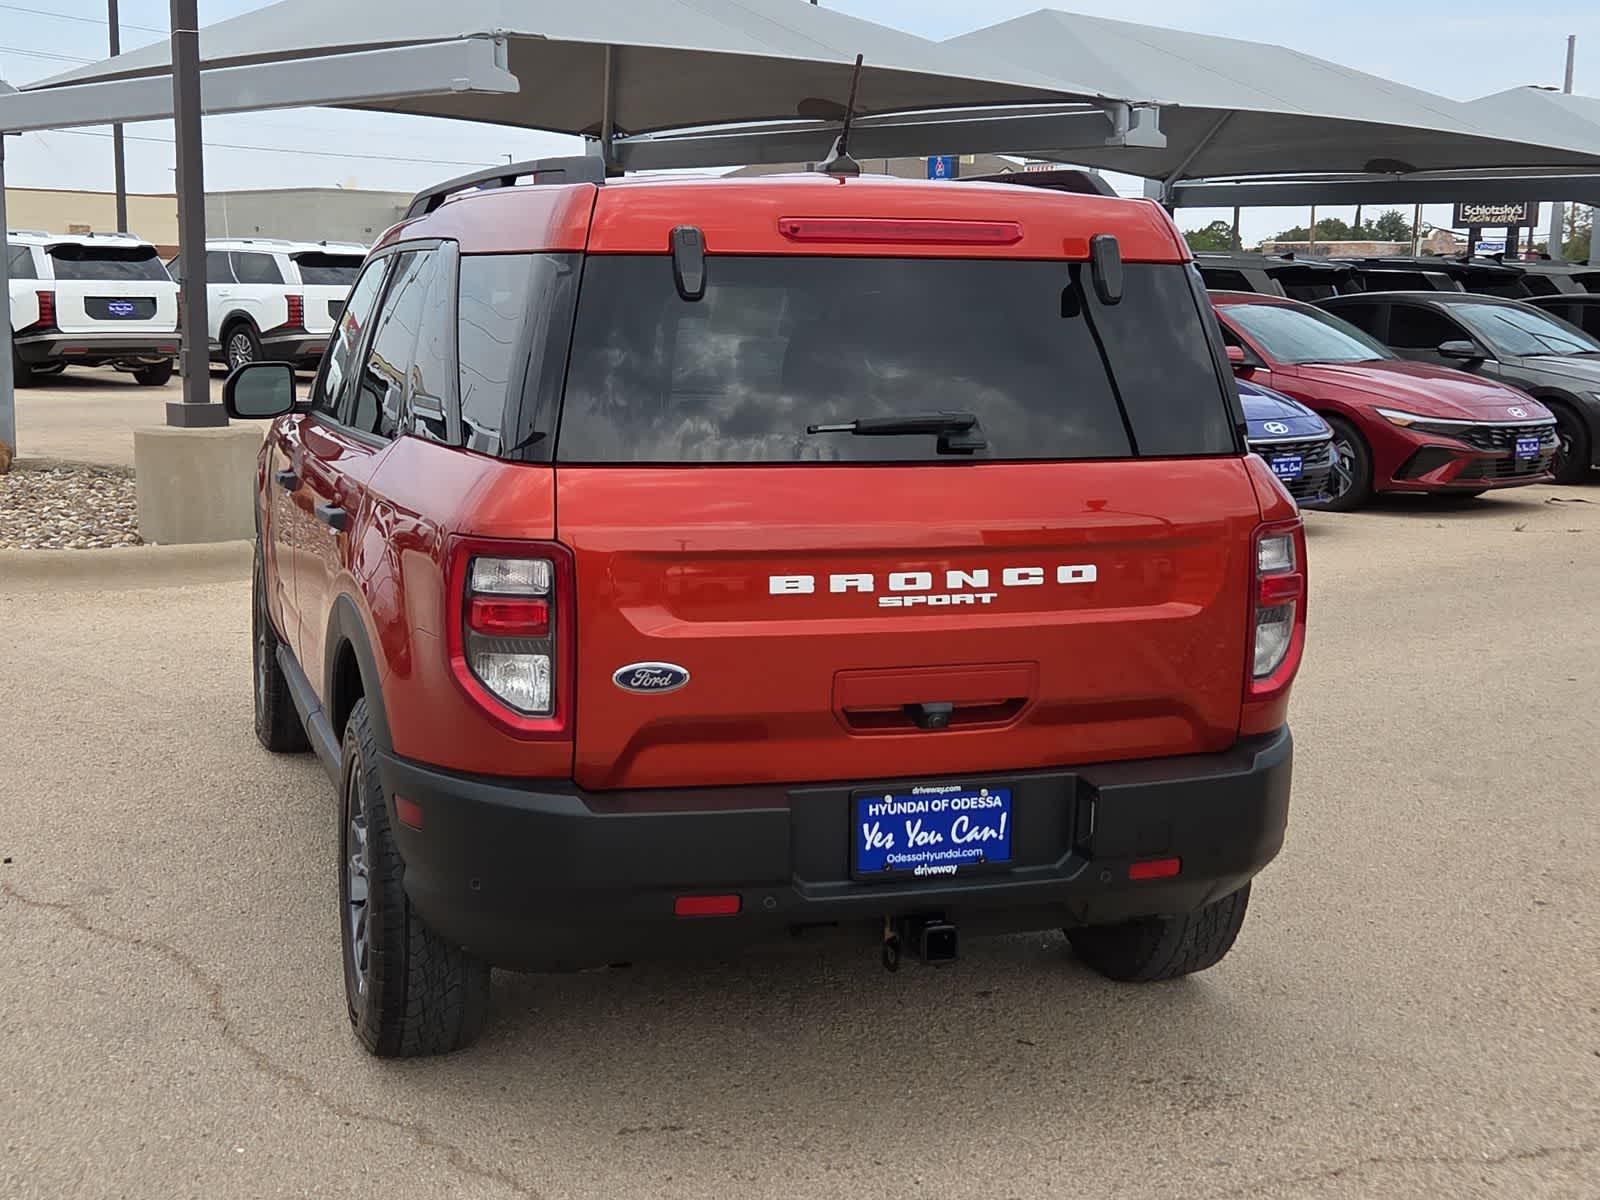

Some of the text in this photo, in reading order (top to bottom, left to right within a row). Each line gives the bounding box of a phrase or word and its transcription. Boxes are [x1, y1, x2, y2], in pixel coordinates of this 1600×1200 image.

[1464, 204, 1522, 216] Schlotzsky's
[769, 564, 1097, 594] BRONCO
[878, 593, 997, 607] SPORT
[630, 669, 672, 686] Ford
[912, 785, 961, 795] driveway.com
[868, 796, 1002, 816] HYUNDAI OF ODESSA
[862, 811, 1008, 851] Yes You Can!
[886, 848, 983, 865] OdessaHyundai.com
[914, 863, 958, 876] driveway
